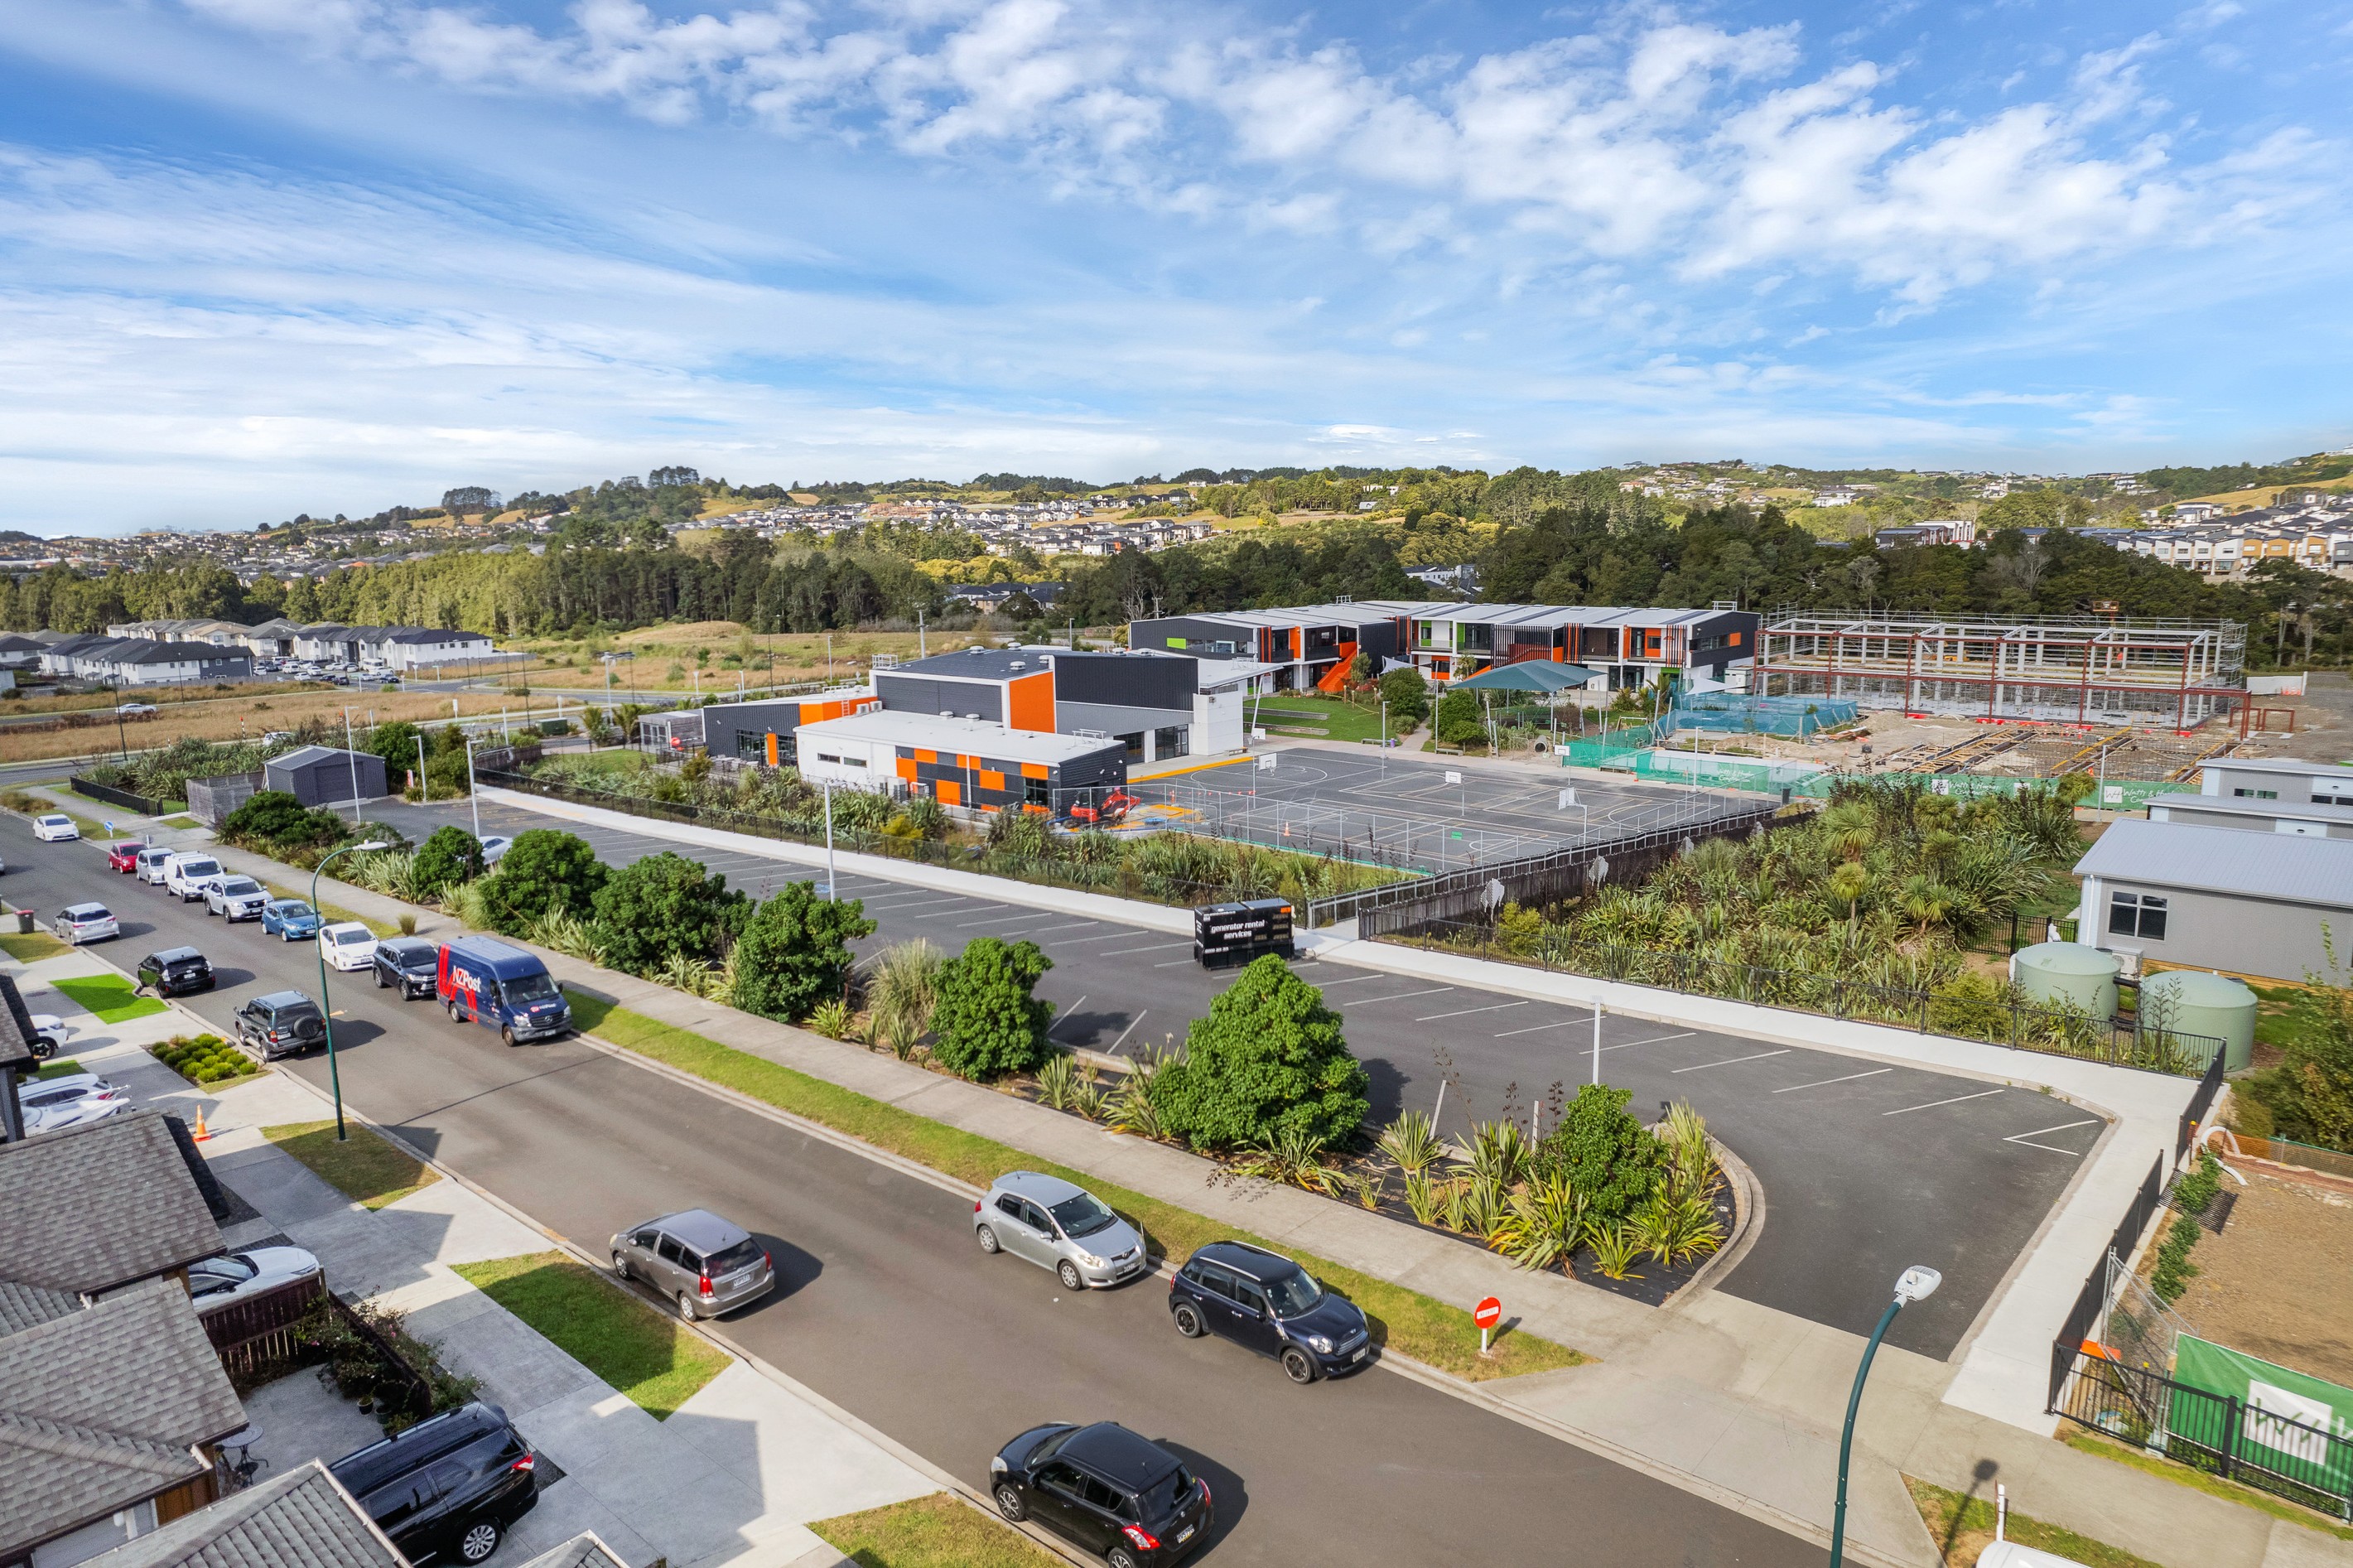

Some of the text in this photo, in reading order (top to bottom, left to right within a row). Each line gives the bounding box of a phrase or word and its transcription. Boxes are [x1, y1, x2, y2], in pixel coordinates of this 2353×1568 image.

[2123, 788, 2146, 797] Watts
[1211, 924, 1244, 934] generator
[1245, 919, 1266, 928] rental
[1224, 930, 1251, 939] services
